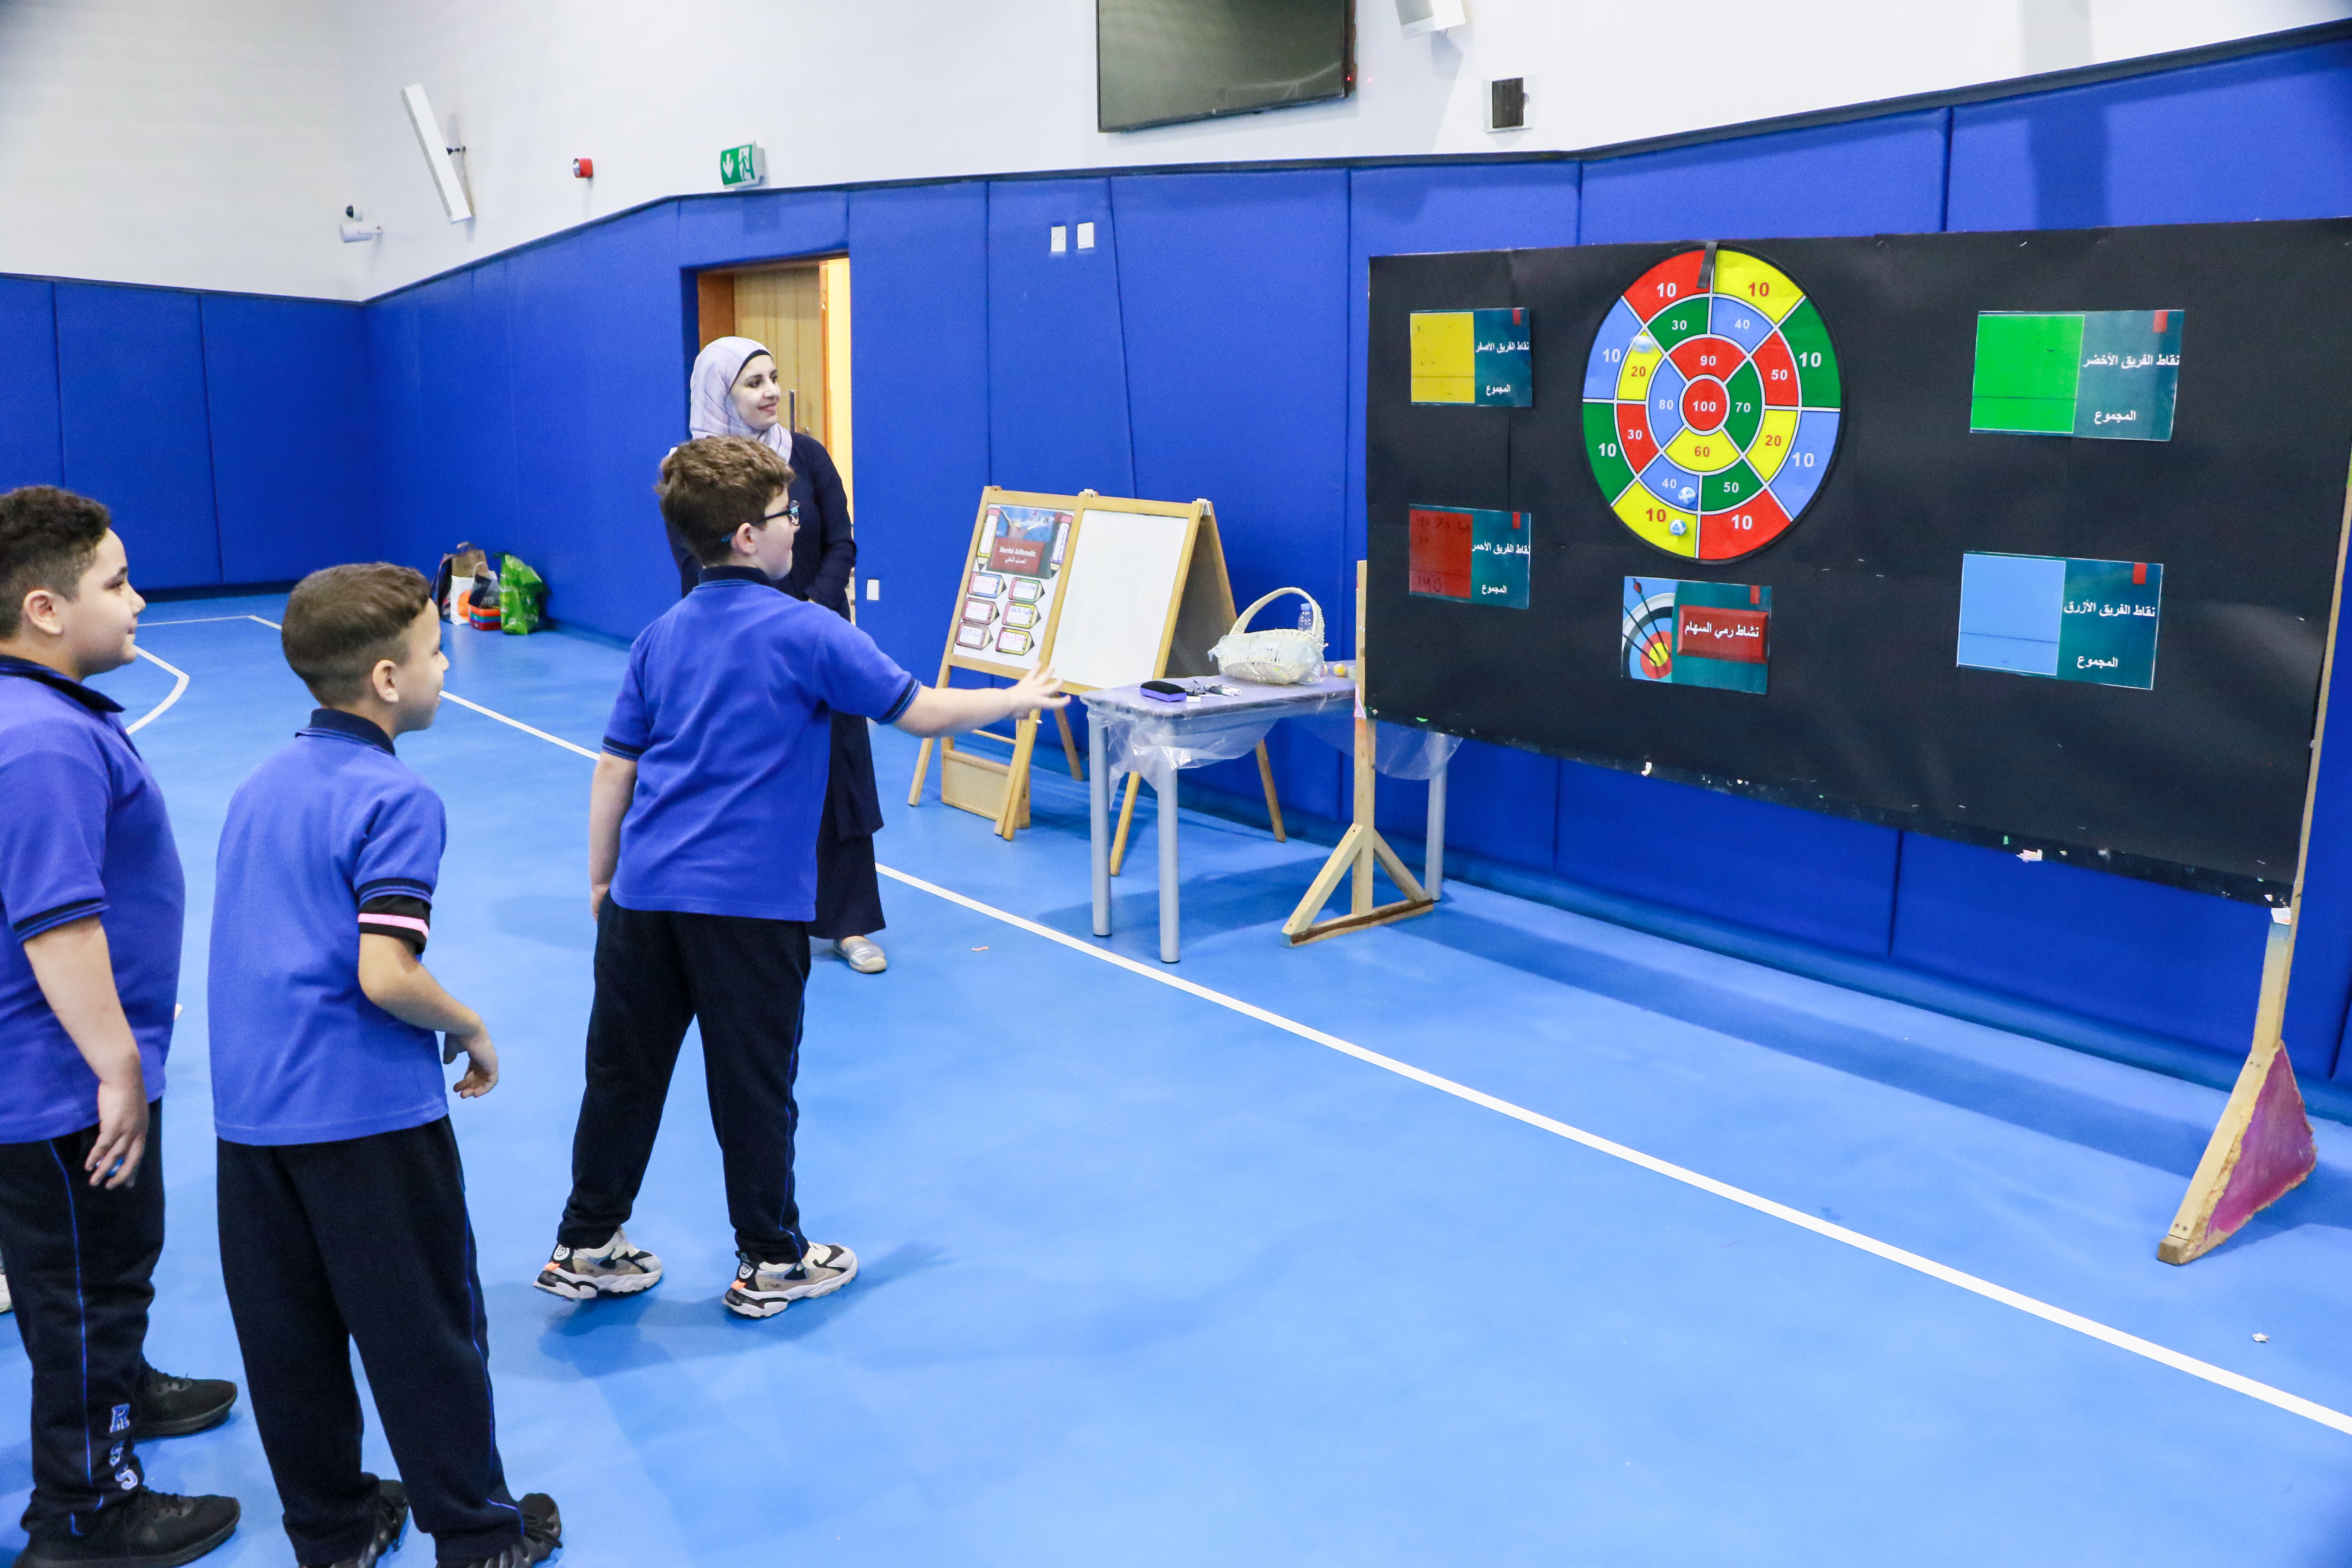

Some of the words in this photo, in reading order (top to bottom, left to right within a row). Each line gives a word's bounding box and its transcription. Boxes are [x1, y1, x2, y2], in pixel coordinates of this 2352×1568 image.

[1657, 282, 1676, 297] 10
[1748, 282, 1770, 297] 10
[1672, 320, 1687, 331] 30
[1734, 318, 1750, 329] 40
[1496, 342, 1516, 353] الفريق
[1517, 341, 1529, 350] نقاط
[1602, 348, 1621, 363] 10
[1700, 355, 1717, 366] 90
[1799, 352, 1822, 368] 10
[2082, 352, 2118, 368] الأخضر
[2120, 354, 2153, 369] الفريق
[2156, 354, 2180, 366] نقاط
[1631, 366, 1646, 377] 20
[1771, 369, 1788, 380] 50
[1486, 384, 1511, 396] المجموع
[1659, 399, 1674, 410] 80
[1693, 401, 1717, 412] 100
[1736, 402, 1751, 413] 70
[2094, 410, 2137, 425] المجموع
[1627, 429, 1643, 440] 30
[1765, 435, 1782, 446] 20
[1598, 443, 1617, 457] 10
[1694, 446, 1710, 457] 60
[1792, 452, 1815, 467] 10
[1662, 478, 1677, 489] 40
[1723, 481, 1740, 493] 50
[1646, 508, 1666, 522] 10
[1731, 514, 1753, 530] 10
[1471, 541, 1491, 551] الأحمر
[1493, 543, 1514, 555] الفريق
[1418, 573, 1442, 592] 140
[1482, 585, 1507, 594] المجموع
[2064, 599, 2097, 614] الأزرق
[2099, 603, 2130, 617] الفريق
[2132, 604, 2155, 617] نقاط
[1684, 621, 1712, 635] السهام
[1714, 628, 1734, 639] رمي
[1735, 624, 1759, 638] نشاط
[2077, 655, 2119, 670] المجموع
